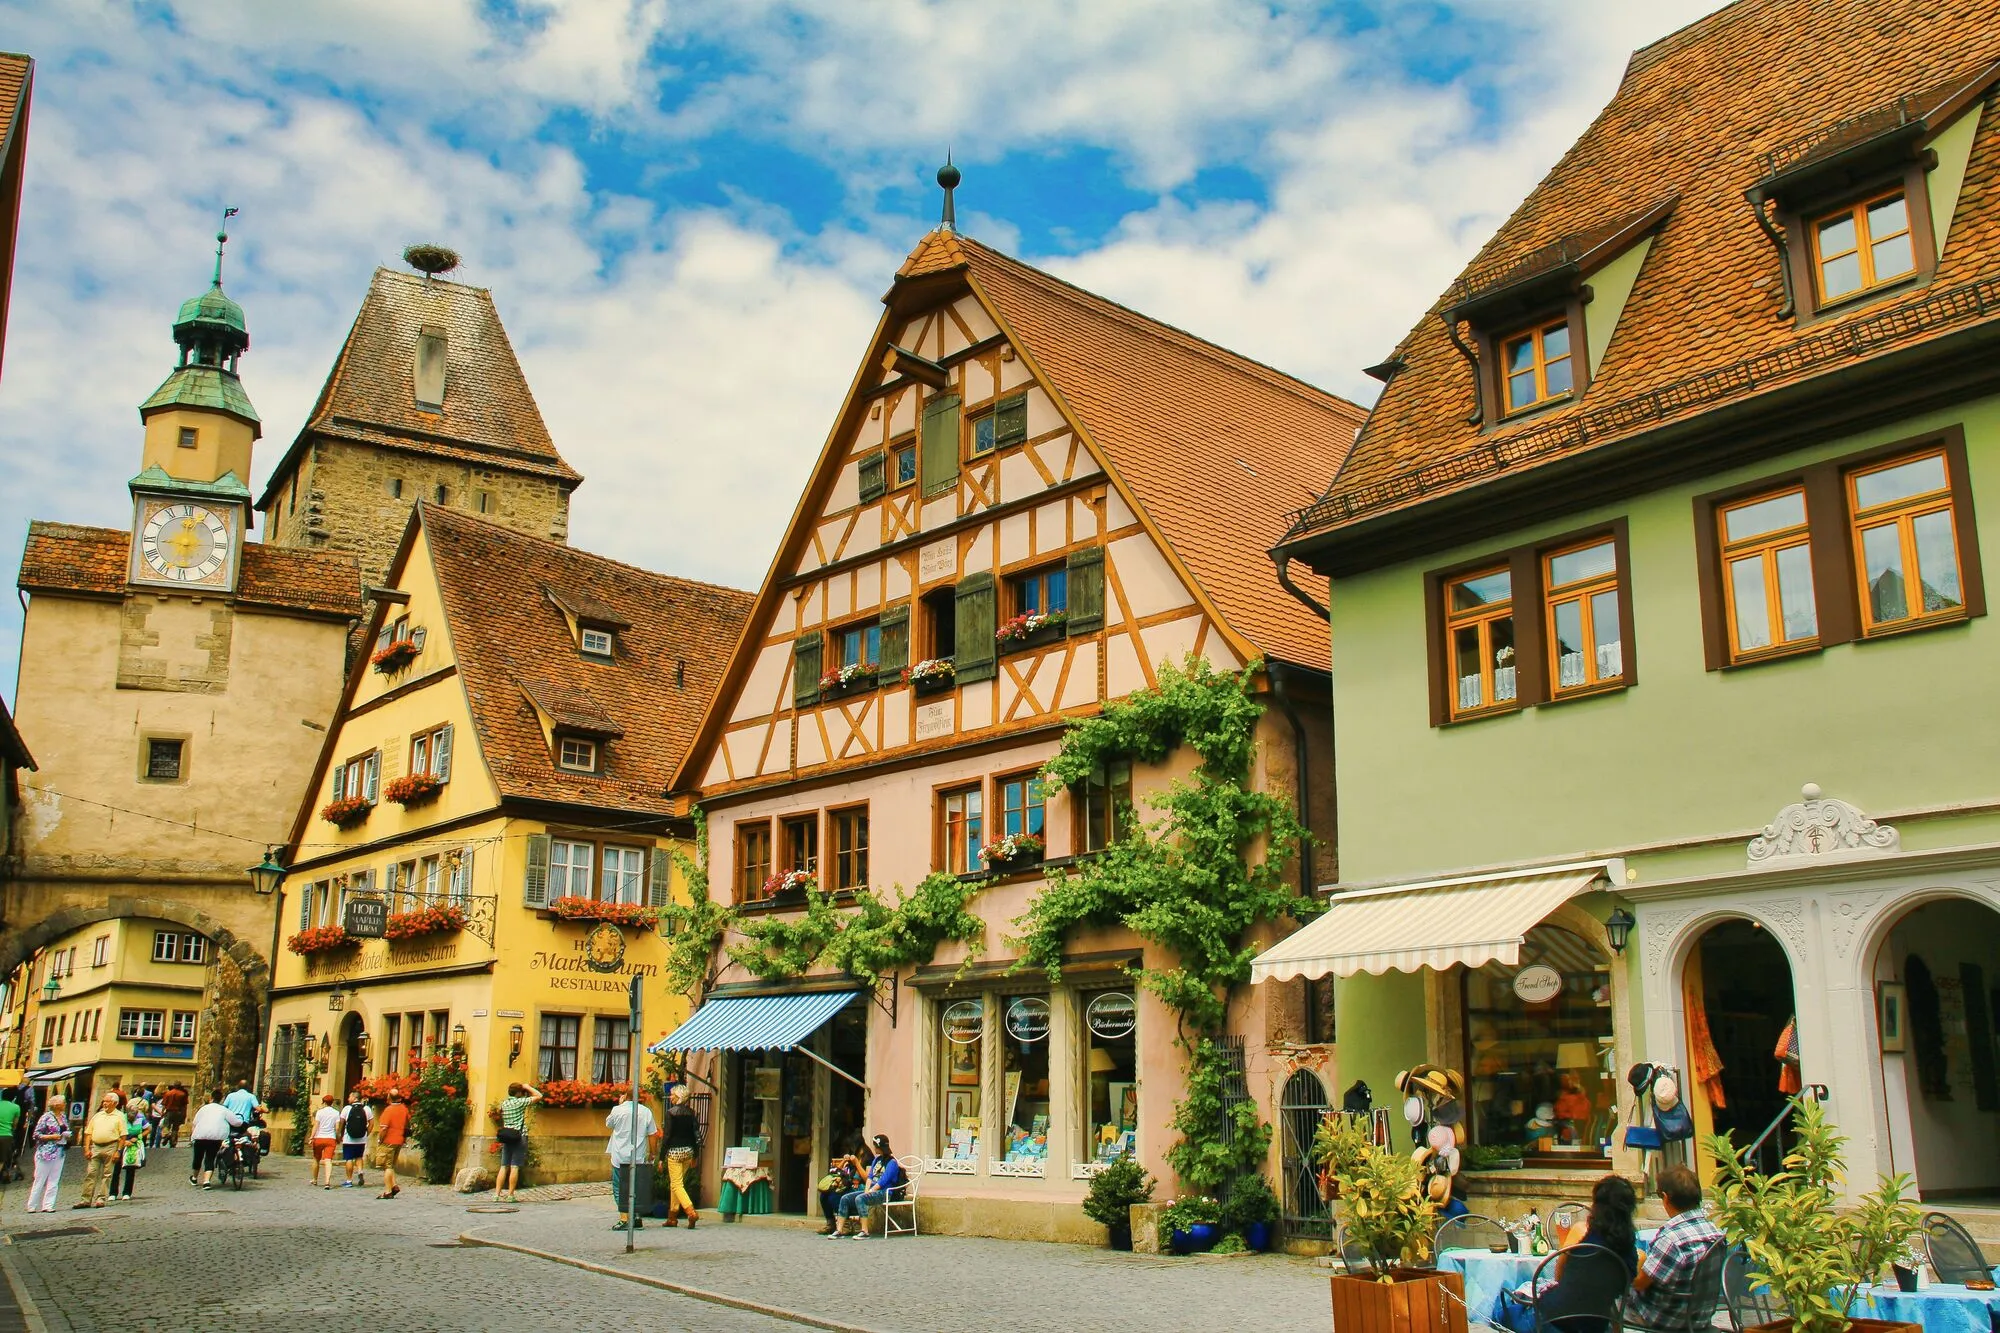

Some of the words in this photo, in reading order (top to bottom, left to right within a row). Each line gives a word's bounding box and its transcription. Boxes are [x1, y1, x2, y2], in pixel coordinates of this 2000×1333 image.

[353, 904, 382, 915] HOTEL
[356, 925, 378, 933] TURM
[550, 977, 631, 993] RESTAURAN
[1516, 977, 1539, 990] Trend
[1539, 975, 1558, 991] Shop
[1092, 1018, 1134, 1029] Büchermarkt
